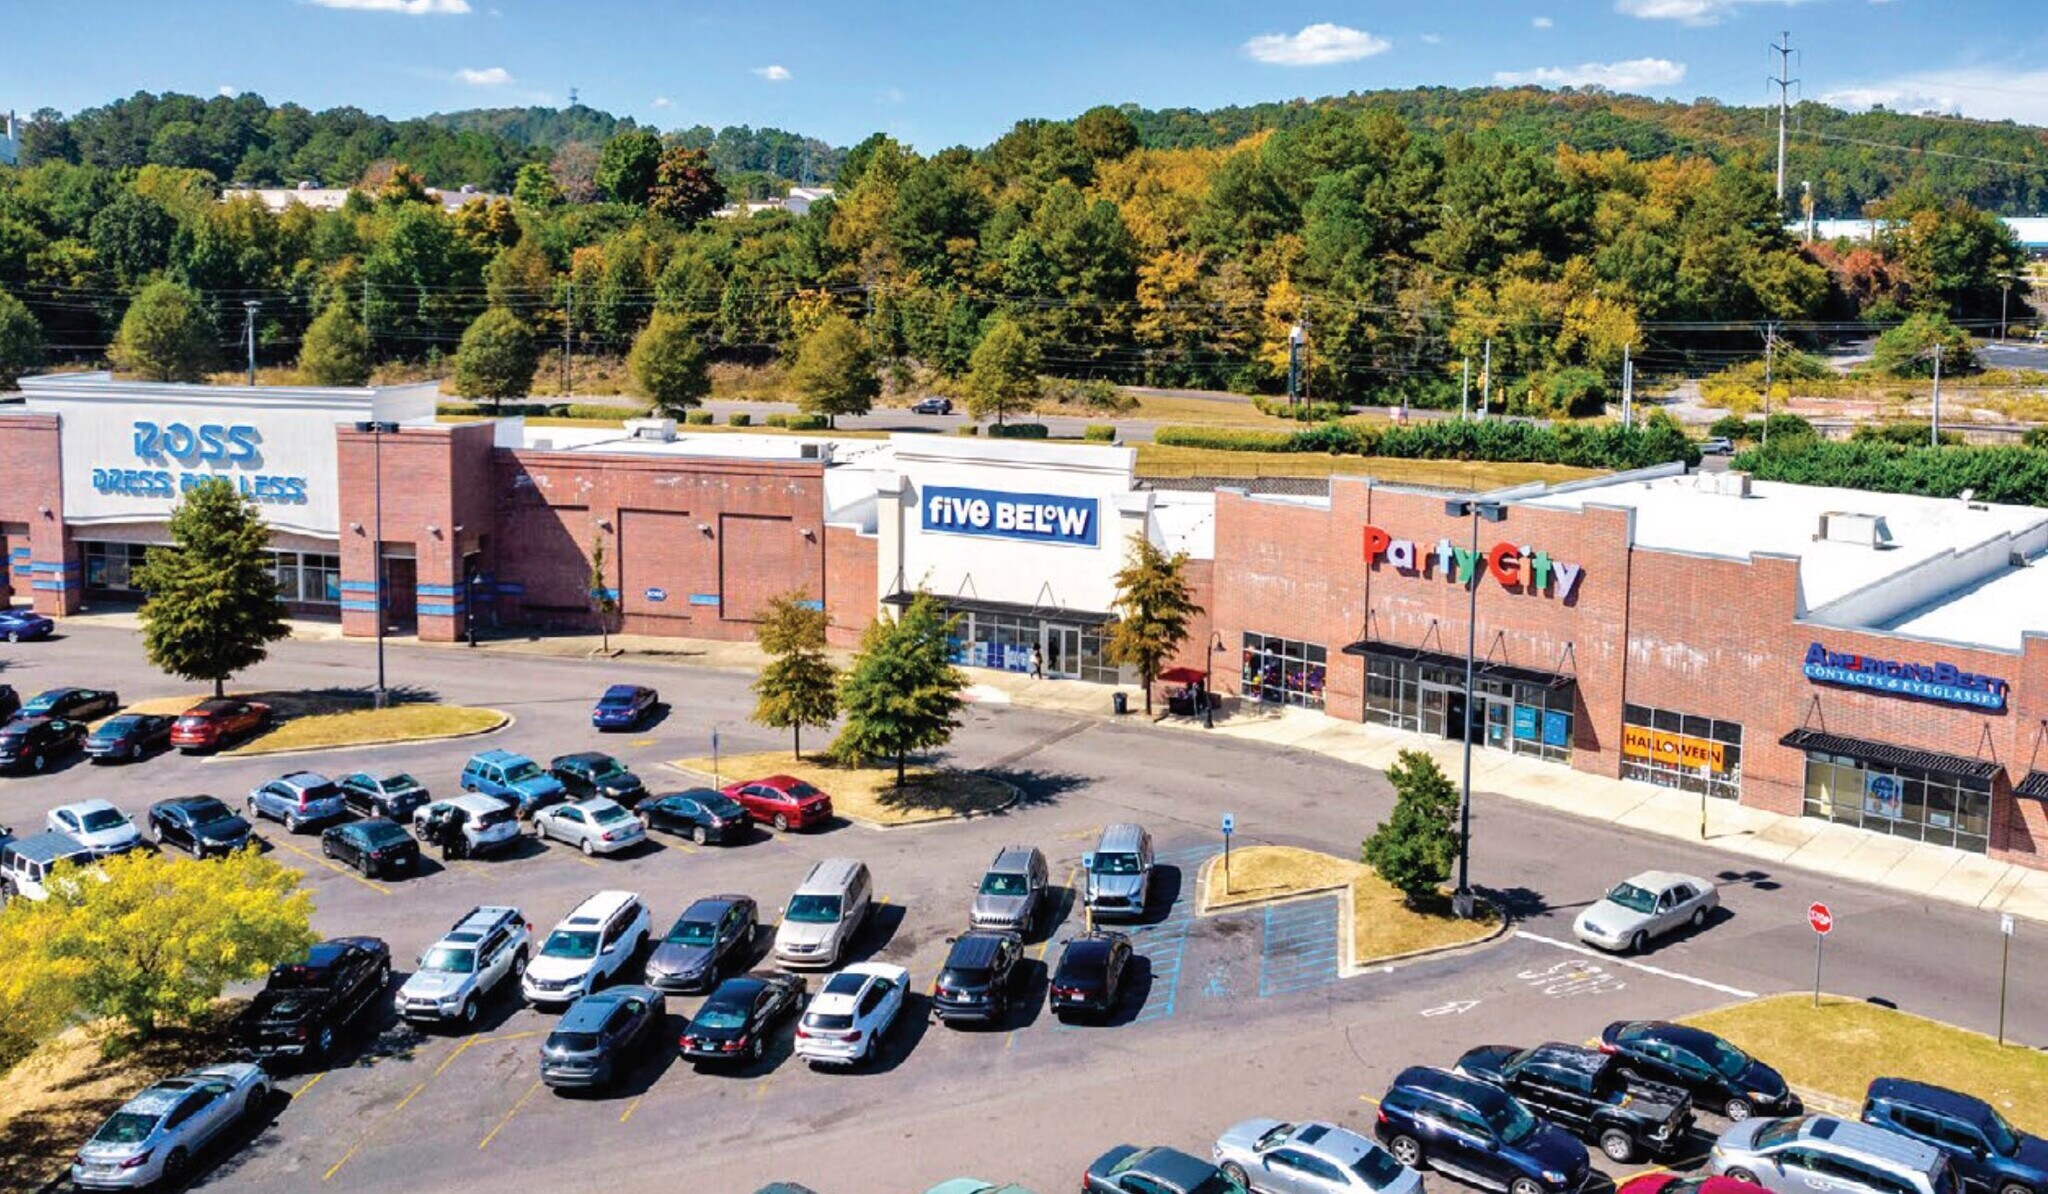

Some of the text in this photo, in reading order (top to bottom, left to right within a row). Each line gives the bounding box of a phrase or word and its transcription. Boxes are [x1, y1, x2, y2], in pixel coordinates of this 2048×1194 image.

[133, 421, 257, 461] ROSS
[92, 468, 170, 493] DRESS
[240, 475, 306, 498] LESS
[929, 496, 1088, 535] five BELOW
[1363, 525, 1580, 598] Party City
[1805, 665, 2000, 705] CONTACTS & EYEGLASSES
[1935, 661, 2006, 695] BEST
[1625, 733, 1721, 763] HALLOWEEN
